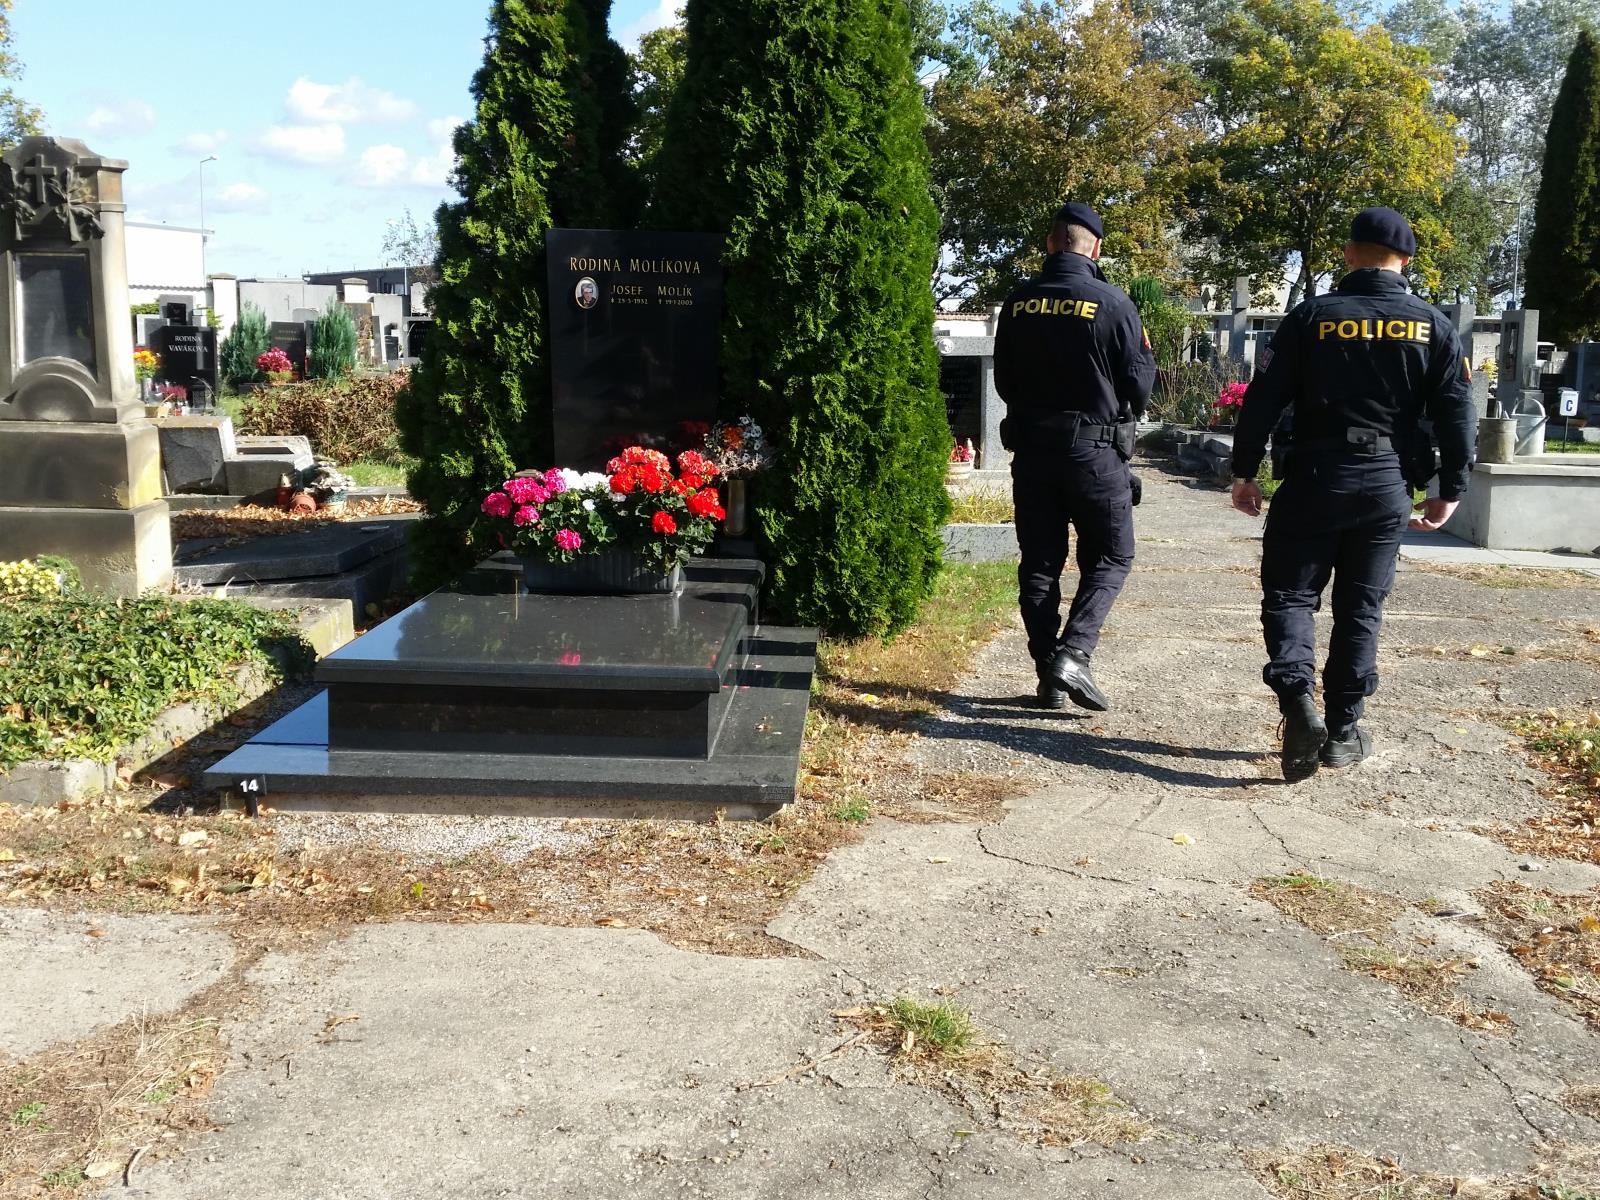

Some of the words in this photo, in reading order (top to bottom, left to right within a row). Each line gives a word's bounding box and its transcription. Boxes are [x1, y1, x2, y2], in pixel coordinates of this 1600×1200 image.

[570, 256, 621, 272] RODINA
[629, 257, 701, 274] MOLÍKOVA
[610, 284, 643, 295] JOSEF
[658, 284, 692, 297] MOLÍK
[1012, 297, 1099, 320] POLICIE
[1319, 319, 1431, 343] POLICIE
[1565, 399, 1573, 412] C
[240, 780, 259, 793] 14
